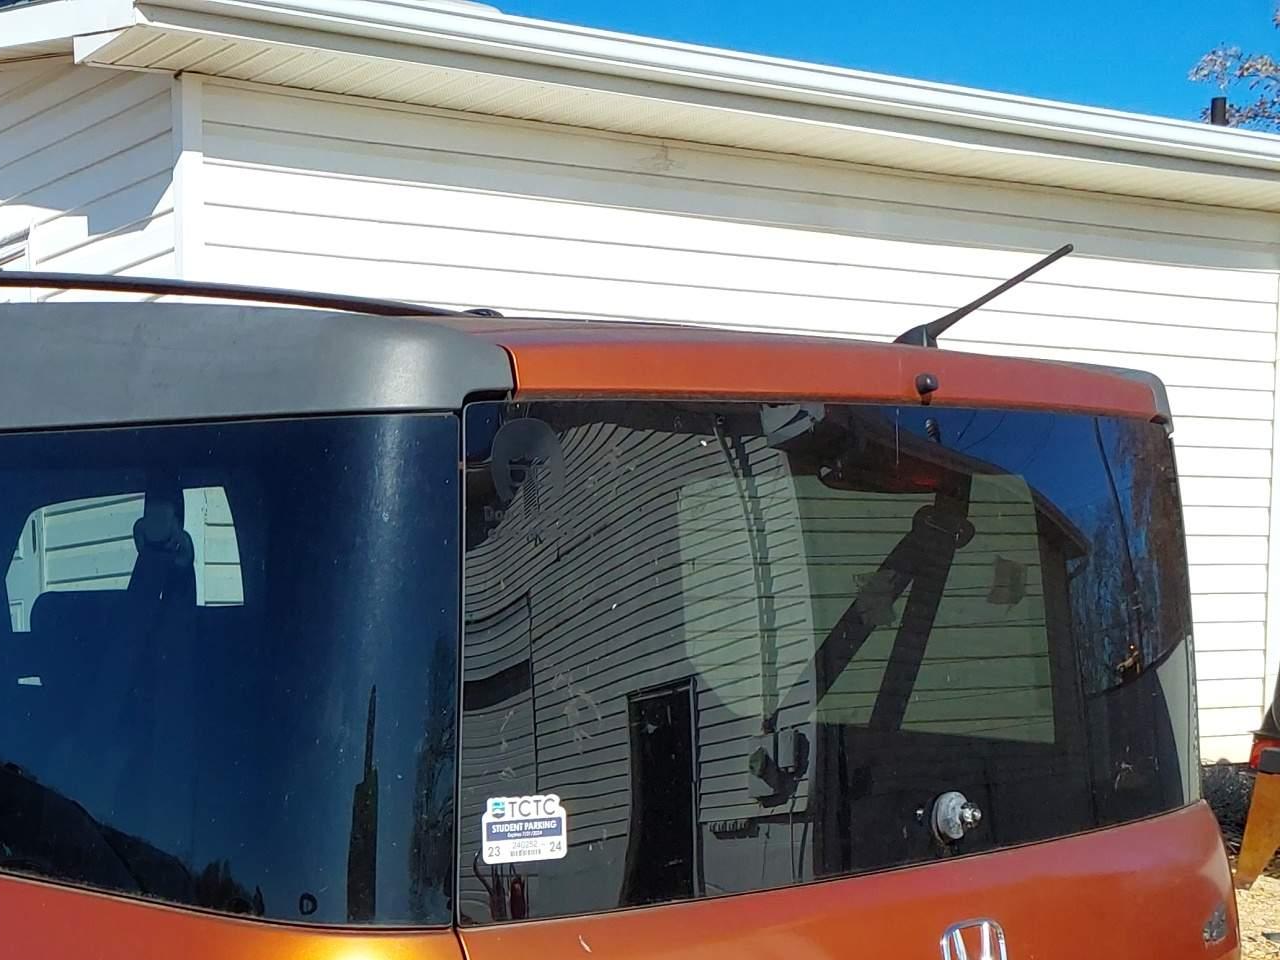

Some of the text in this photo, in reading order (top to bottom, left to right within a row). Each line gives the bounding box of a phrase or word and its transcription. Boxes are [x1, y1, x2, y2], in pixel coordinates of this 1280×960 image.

[508, 797, 556, 817] TCTC
[492, 820, 556, 833] STUDENT PARKING
[487, 846, 501, 857] 23
[549, 841, 562, 852] 24
